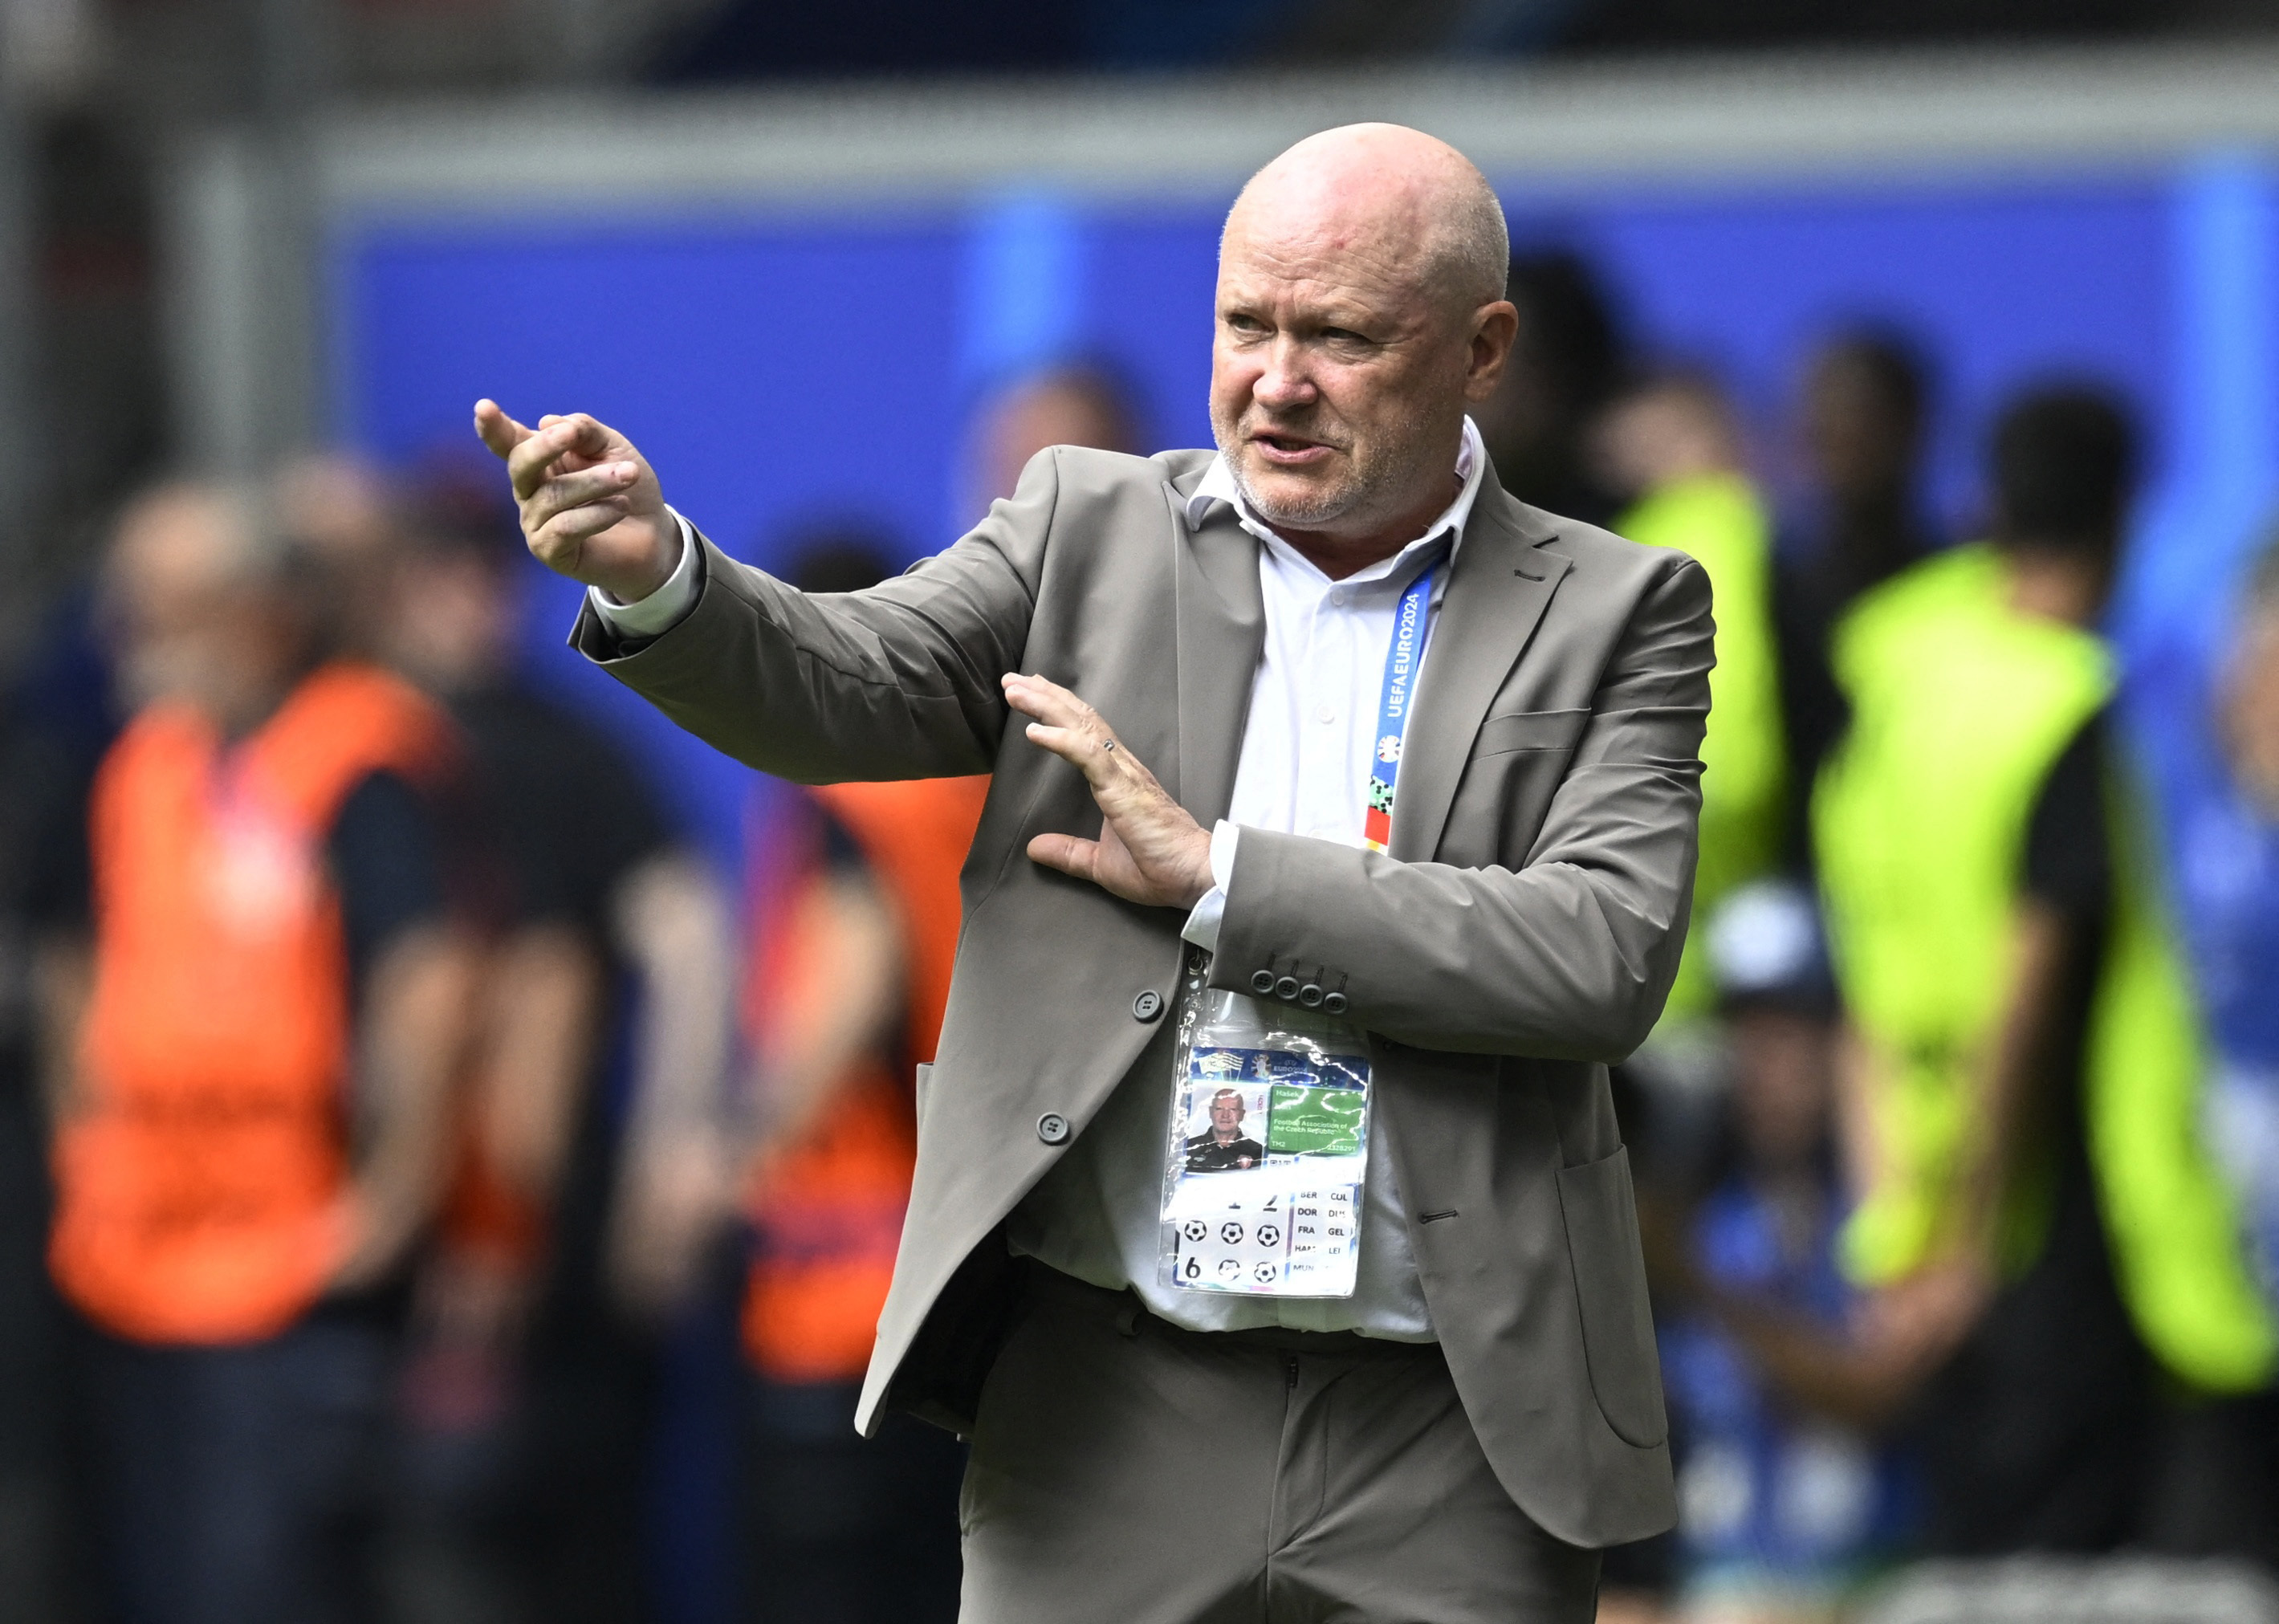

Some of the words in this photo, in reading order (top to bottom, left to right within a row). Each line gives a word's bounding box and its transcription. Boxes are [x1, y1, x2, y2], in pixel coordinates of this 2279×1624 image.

[1285, 1125, 1306, 1134] Czech
[1297, 1207, 1317, 1216] DOR
[1297, 1225, 1315, 1235] FRA
[1328, 1227, 1345, 1236] GEL
[1185, 1256, 1201, 1279] 6
